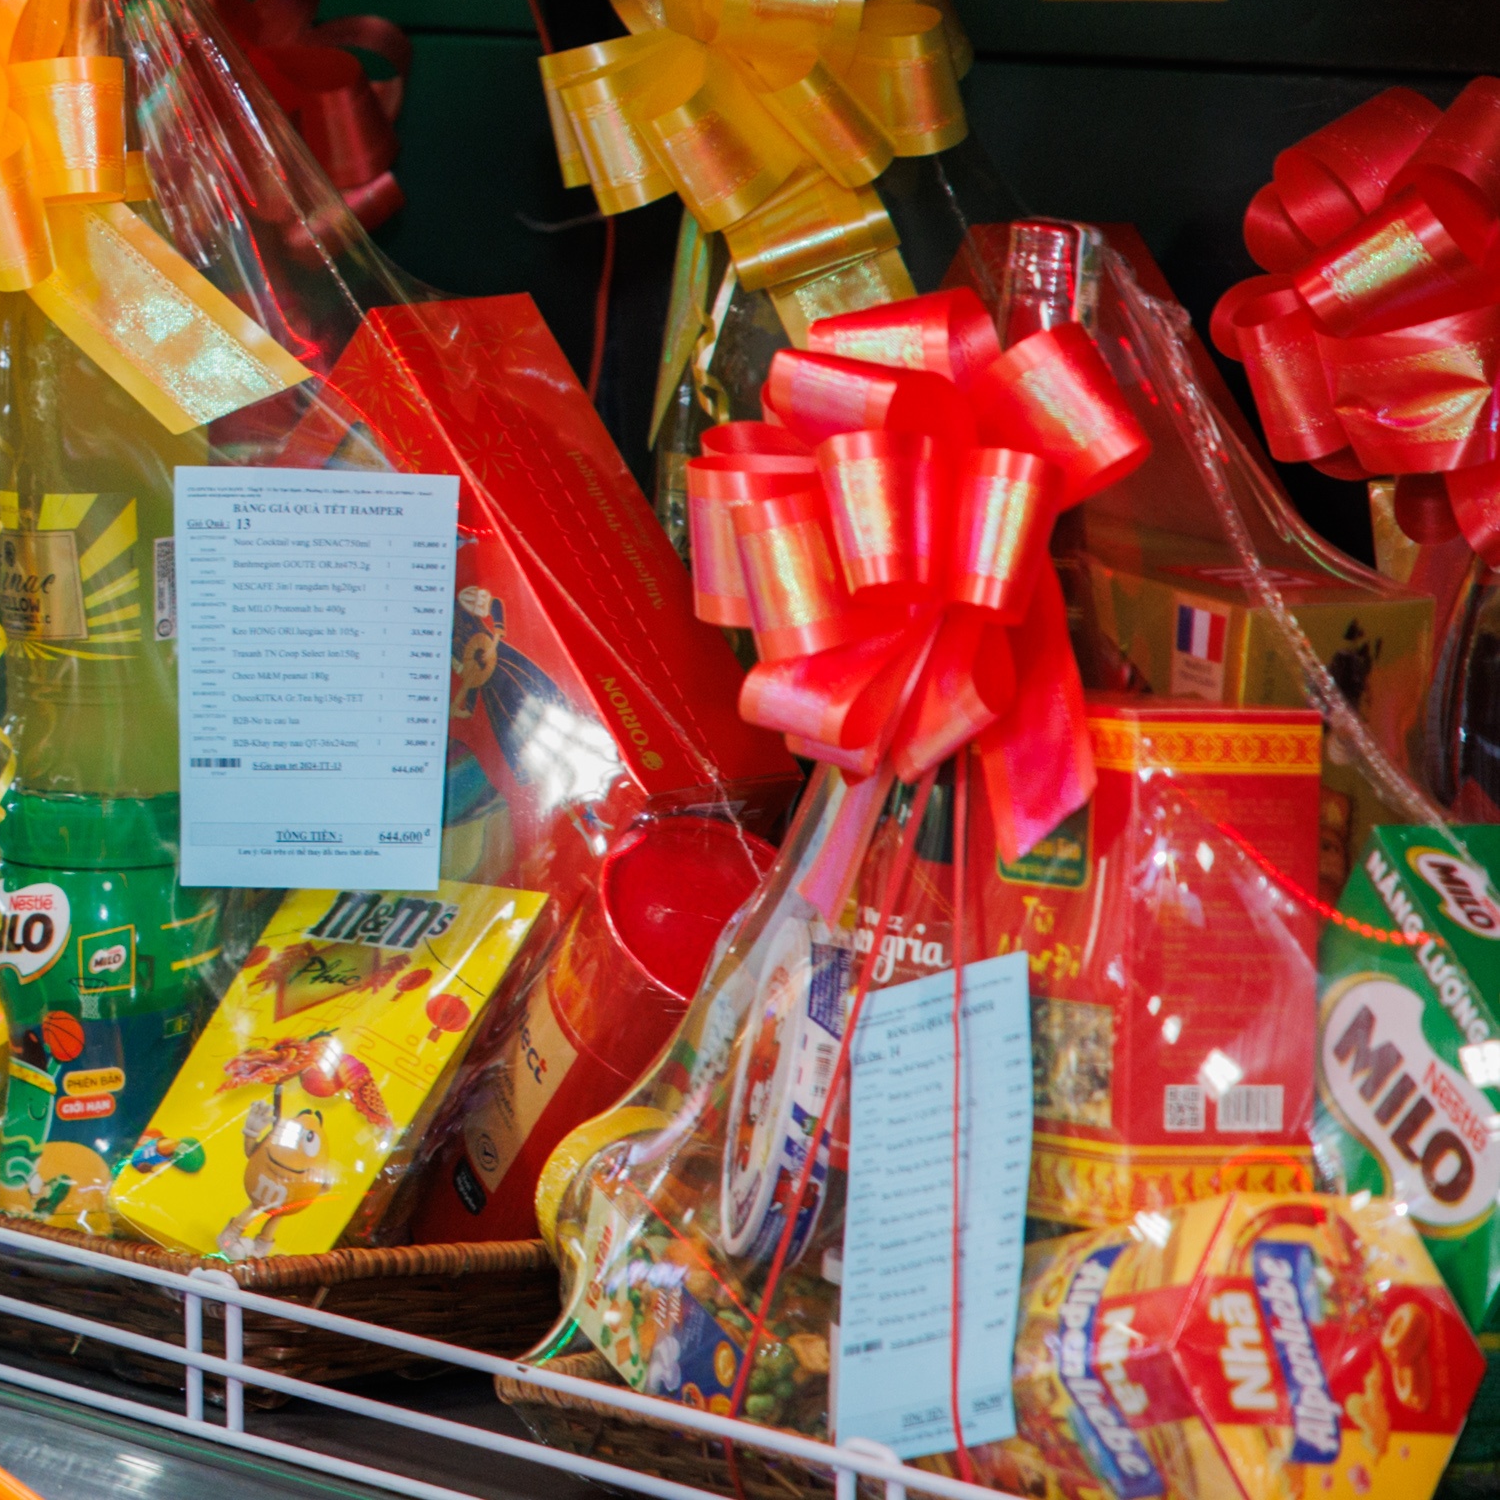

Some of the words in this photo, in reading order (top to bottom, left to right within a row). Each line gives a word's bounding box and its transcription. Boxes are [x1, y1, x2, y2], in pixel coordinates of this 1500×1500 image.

[350, 505, 404, 518] HAMPER
[235, 517, 252, 531] 13
[256, 537, 289, 548] Cocktail
[290, 539, 311, 550] vang
[232, 582, 272, 591] NESCAFE
[247, 604, 272, 613] MILO
[325, 605, 346, 616] 400g
[249, 627, 276, 636] HONG
[278, 650, 299, 661] Coop
[301, 650, 325, 659] Select
[257, 671, 281, 681] M&M
[282, 672, 308, 682] peanut
[310, 672, 329, 683] 180g
[600, 676, 651, 750] ORION
[378, 830, 423, 844] 644,600
[1426, 860, 1496, 930] MILO
[94, 953, 122, 968] MILO
[288, 955, 361, 988] Phúc
[66, 1074, 98, 1090] PHIÊN
[100, 1072, 122, 1087] BẢN
[1333, 1004, 1474, 1207] MILO
[1208, 1291, 1279, 1411] Nhã
[1259, 1256, 1344, 1455] Alpenliebe
